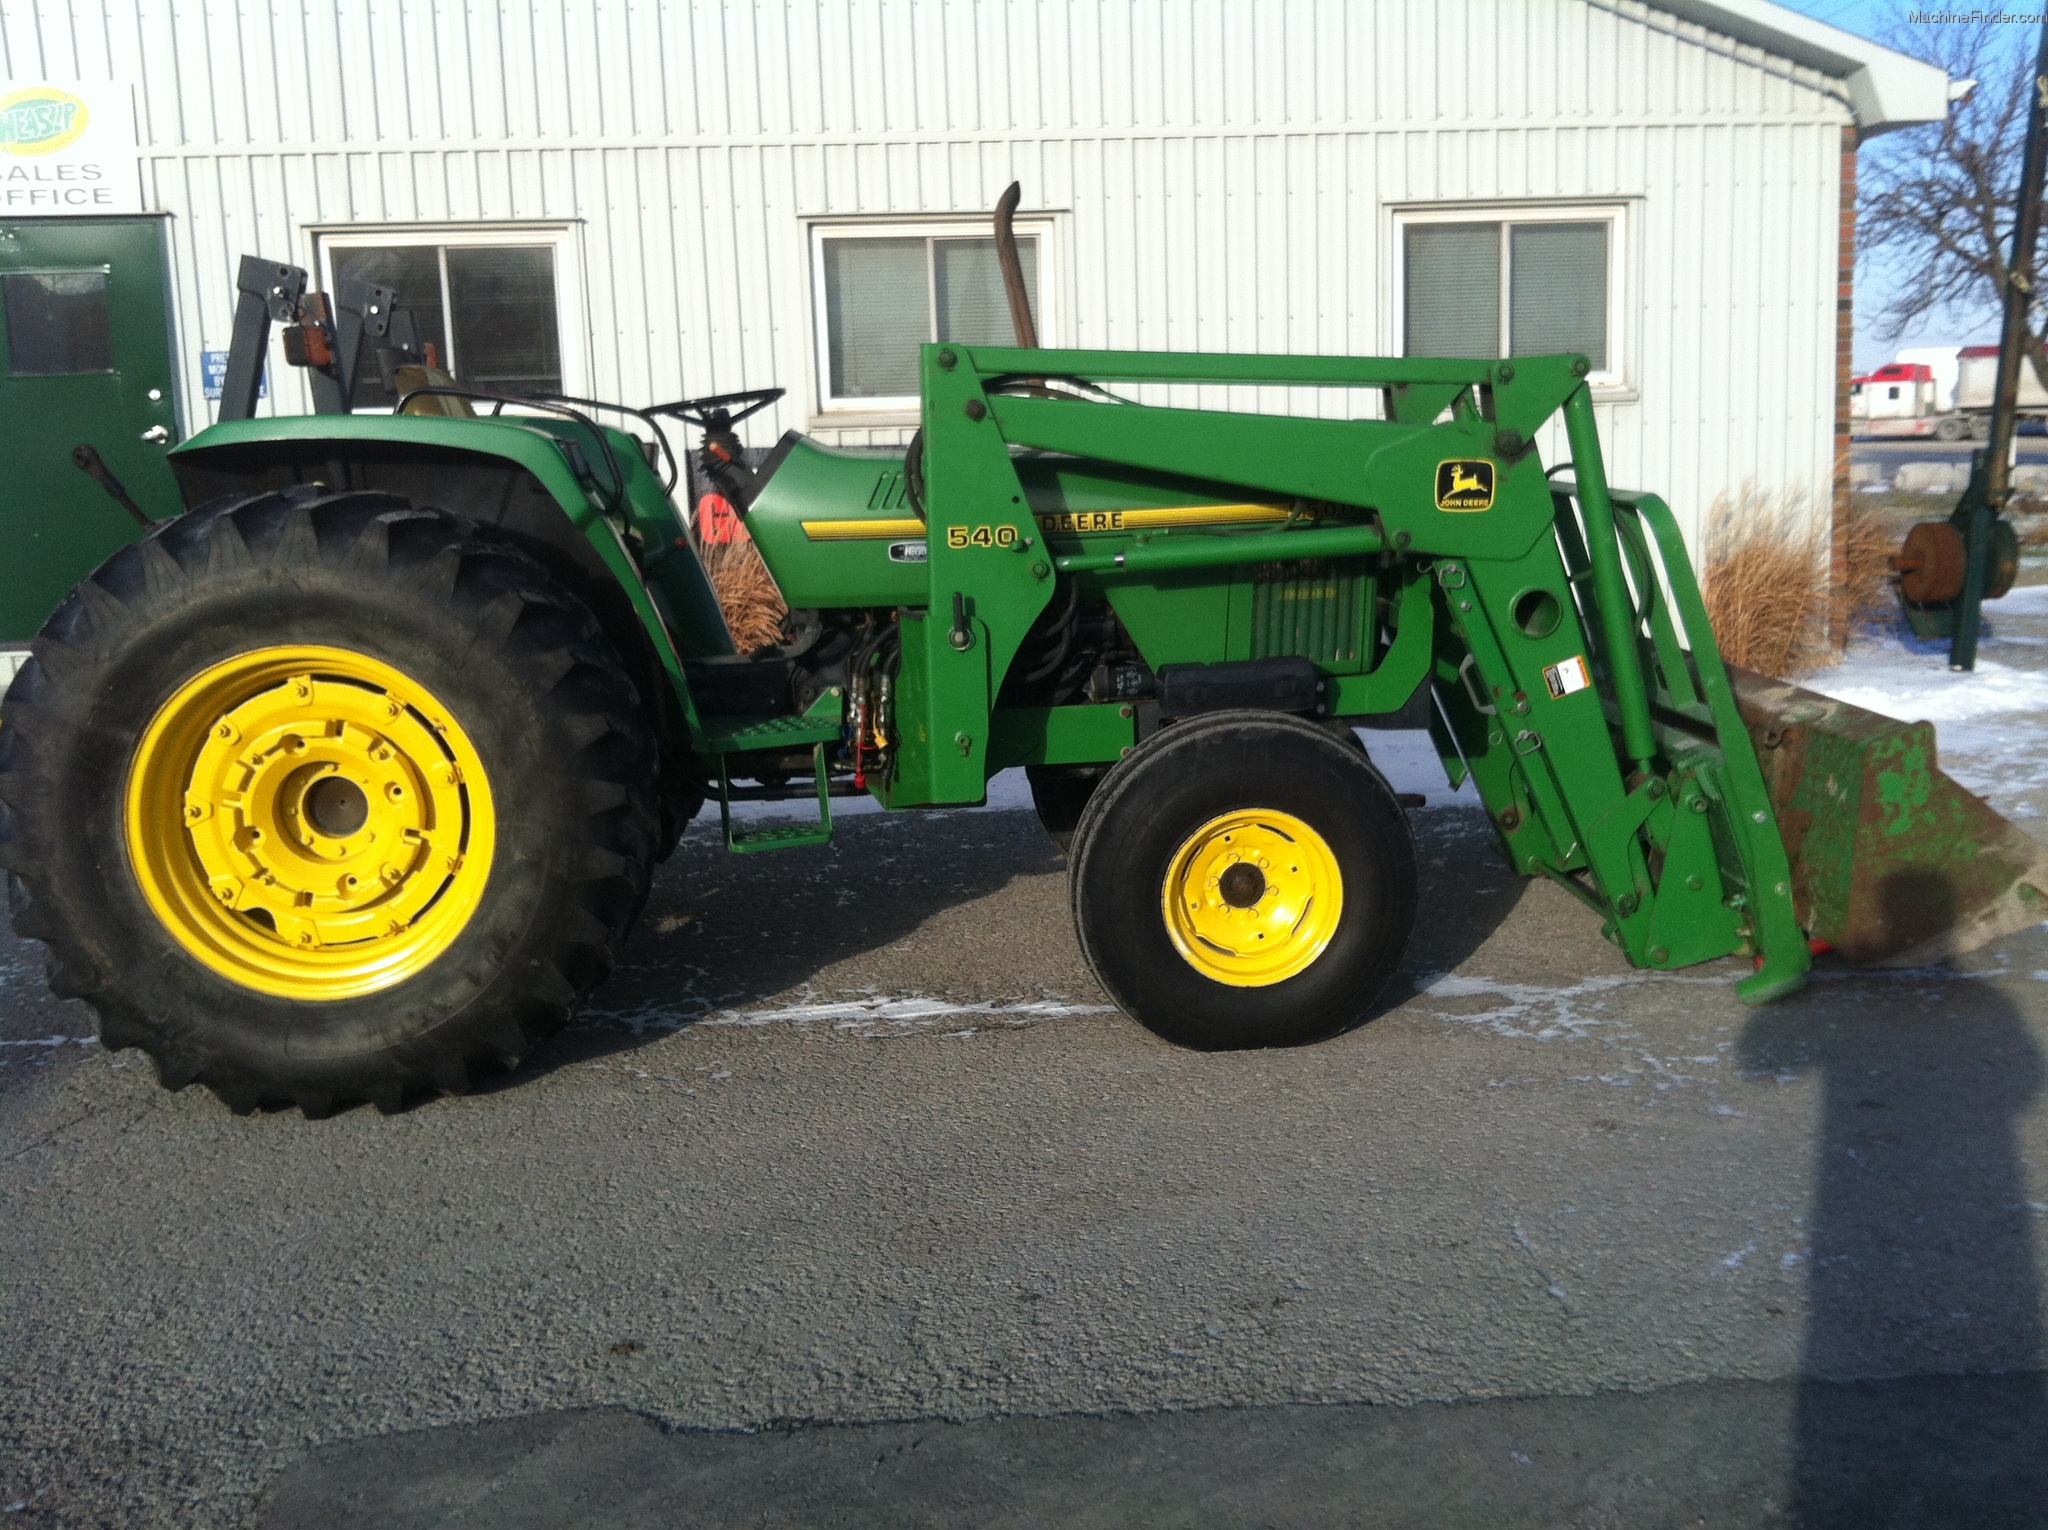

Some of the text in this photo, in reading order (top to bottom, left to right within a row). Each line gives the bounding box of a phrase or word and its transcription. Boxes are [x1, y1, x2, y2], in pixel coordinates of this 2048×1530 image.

[0, 163, 103, 182] ALES
[0, 188, 114, 206] FFICE
[1440, 499, 1489, 507] JOHN DEERE
[1042, 512, 1124, 533] DEERE
[947, 525, 1018, 549] 540
